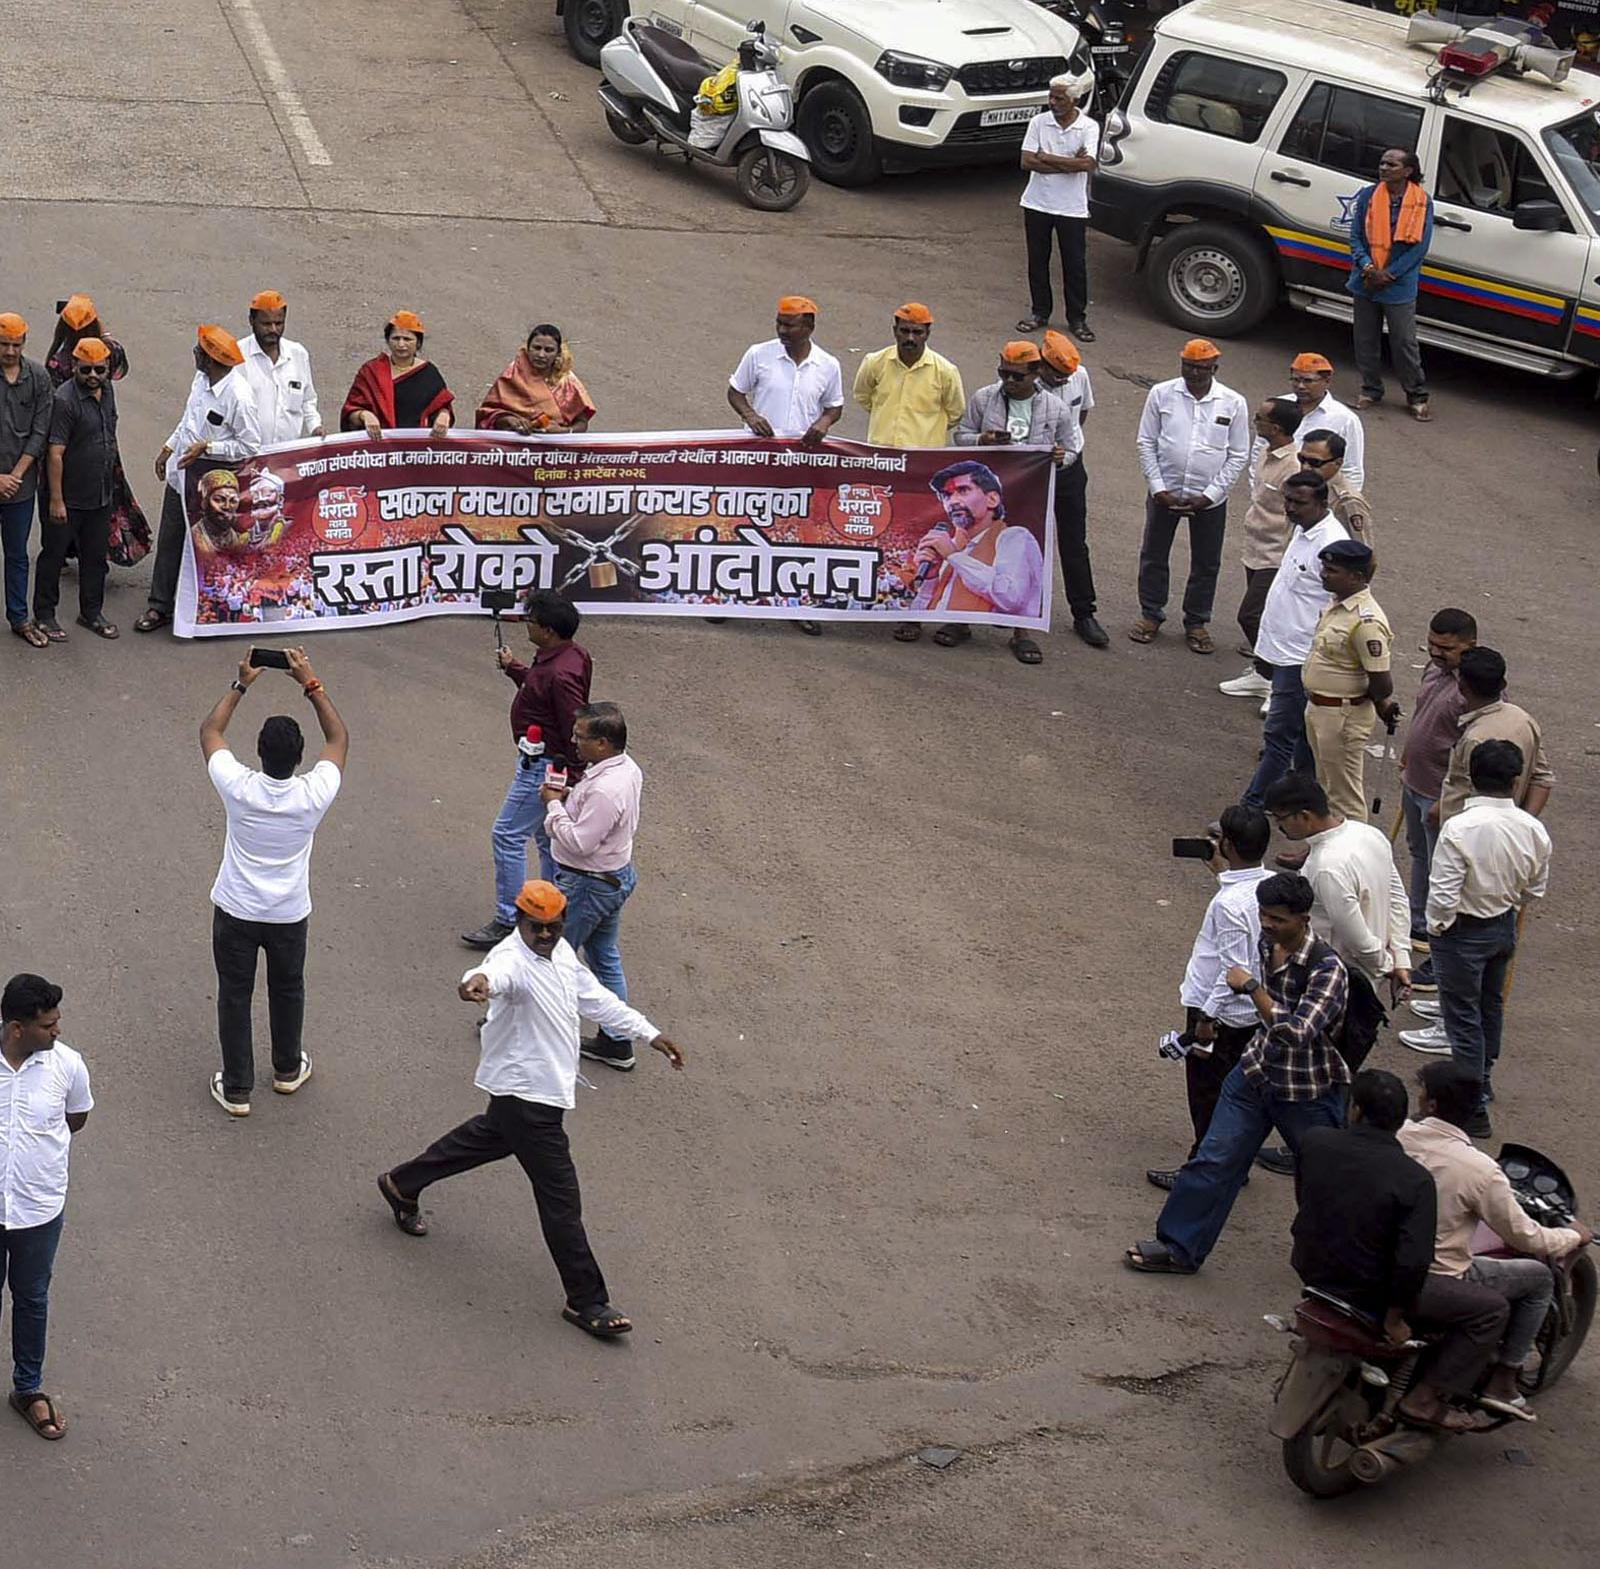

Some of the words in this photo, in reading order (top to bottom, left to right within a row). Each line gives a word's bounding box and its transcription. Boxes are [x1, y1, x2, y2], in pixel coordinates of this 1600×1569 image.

[296, 461, 328, 480] मराठा
[470, 448, 503, 467] जरांगे
[505, 448, 543, 467] पाटील
[545, 450, 578, 465] यांच्या
[581, 450, 639, 465] अंतरवाली
[640, 449, 677, 465] सराटी
[678, 448, 717, 465] येथील
[719, 449, 770, 467] आमरण
[772, 450, 838, 469] उपोषणाच्या
[840, 453, 908, 473] समर्थनार्थ
[534, 467, 567, 482] दिनांक
[573, 469, 580, 480] ३
[581, 466, 617, 480] सप्टेंबर
[618, 468, 647, 479] २०२६
[318, 502, 358, 519] मराठा
[377, 486, 458, 521] सकल
[458, 486, 544, 517] मराठा
[544, 486, 634, 518] समाज
[636, 485, 714, 517] कराड
[715, 486, 813, 527] तालुका
[836, 498, 883, 516] मराठा
[312, 544, 424, 605] रस्ता
[430, 527, 561, 590] रोको
[638, 528, 880, 601] आंदोलन
